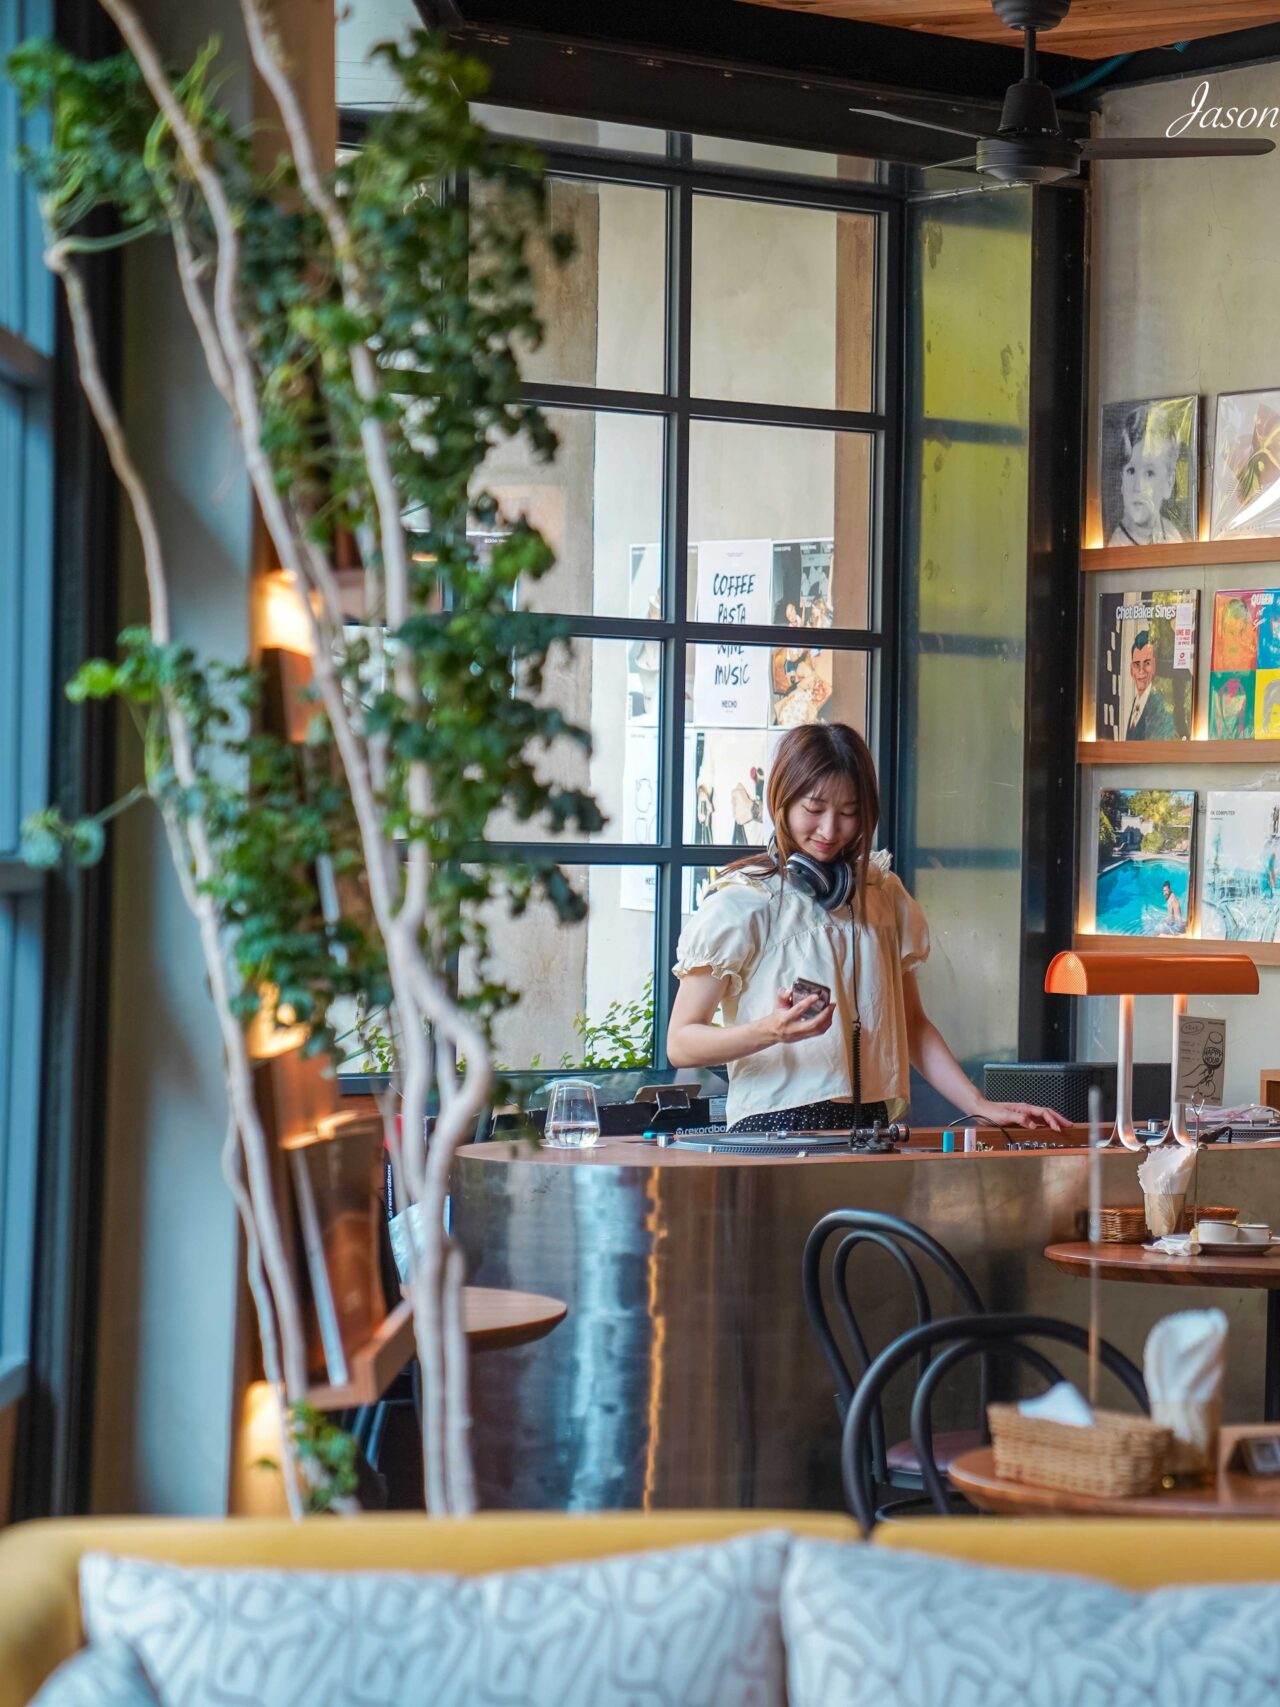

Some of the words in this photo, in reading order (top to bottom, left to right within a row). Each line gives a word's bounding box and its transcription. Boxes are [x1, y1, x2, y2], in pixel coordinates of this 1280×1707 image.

[713, 573, 756, 597] COFFEE
[1251, 593, 1274, 607] QUEEN
[717, 603, 746, 624] PASTA
[1116, 606, 1133, 619] Chet
[1133, 605, 1154, 619] Baker
[1155, 604, 1176, 620] Sings
[714, 663, 750, 686] MUSIC
[684, 1125, 727, 1135] rekordbo
